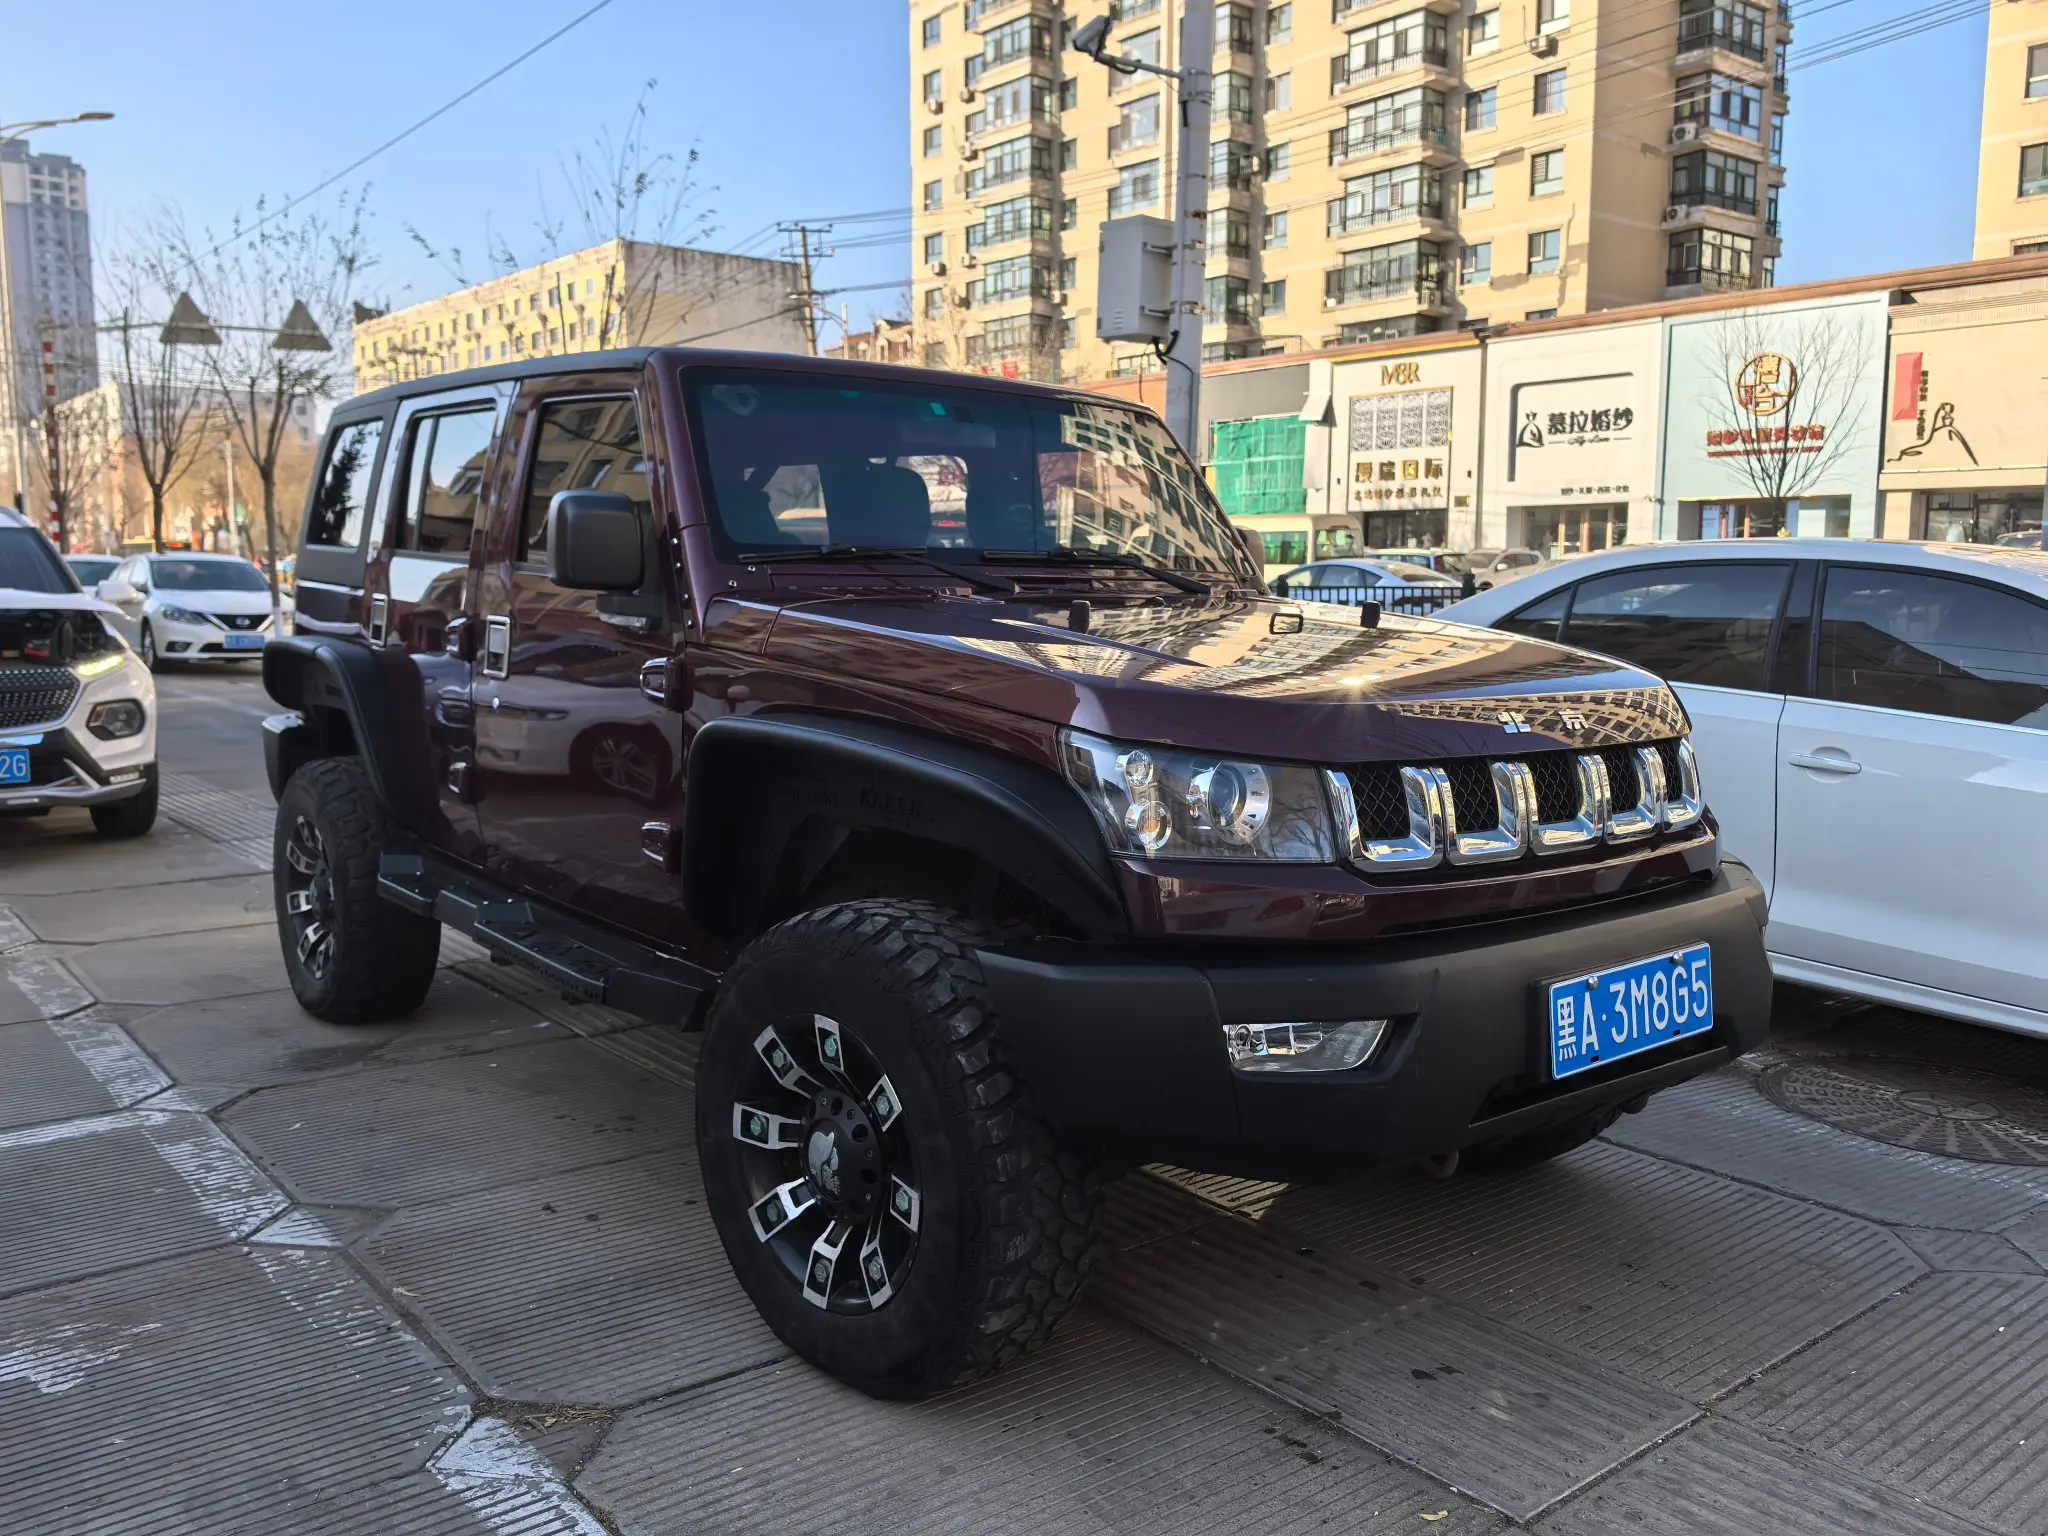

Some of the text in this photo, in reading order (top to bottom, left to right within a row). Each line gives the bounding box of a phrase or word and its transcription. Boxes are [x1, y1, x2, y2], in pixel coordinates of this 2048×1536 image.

[1547, 407, 1633, 435] 慕拉婚纱
[1497, 709, 1589, 734] 北京
[1557, 959, 1709, 1062] 黑A·3M8G5
